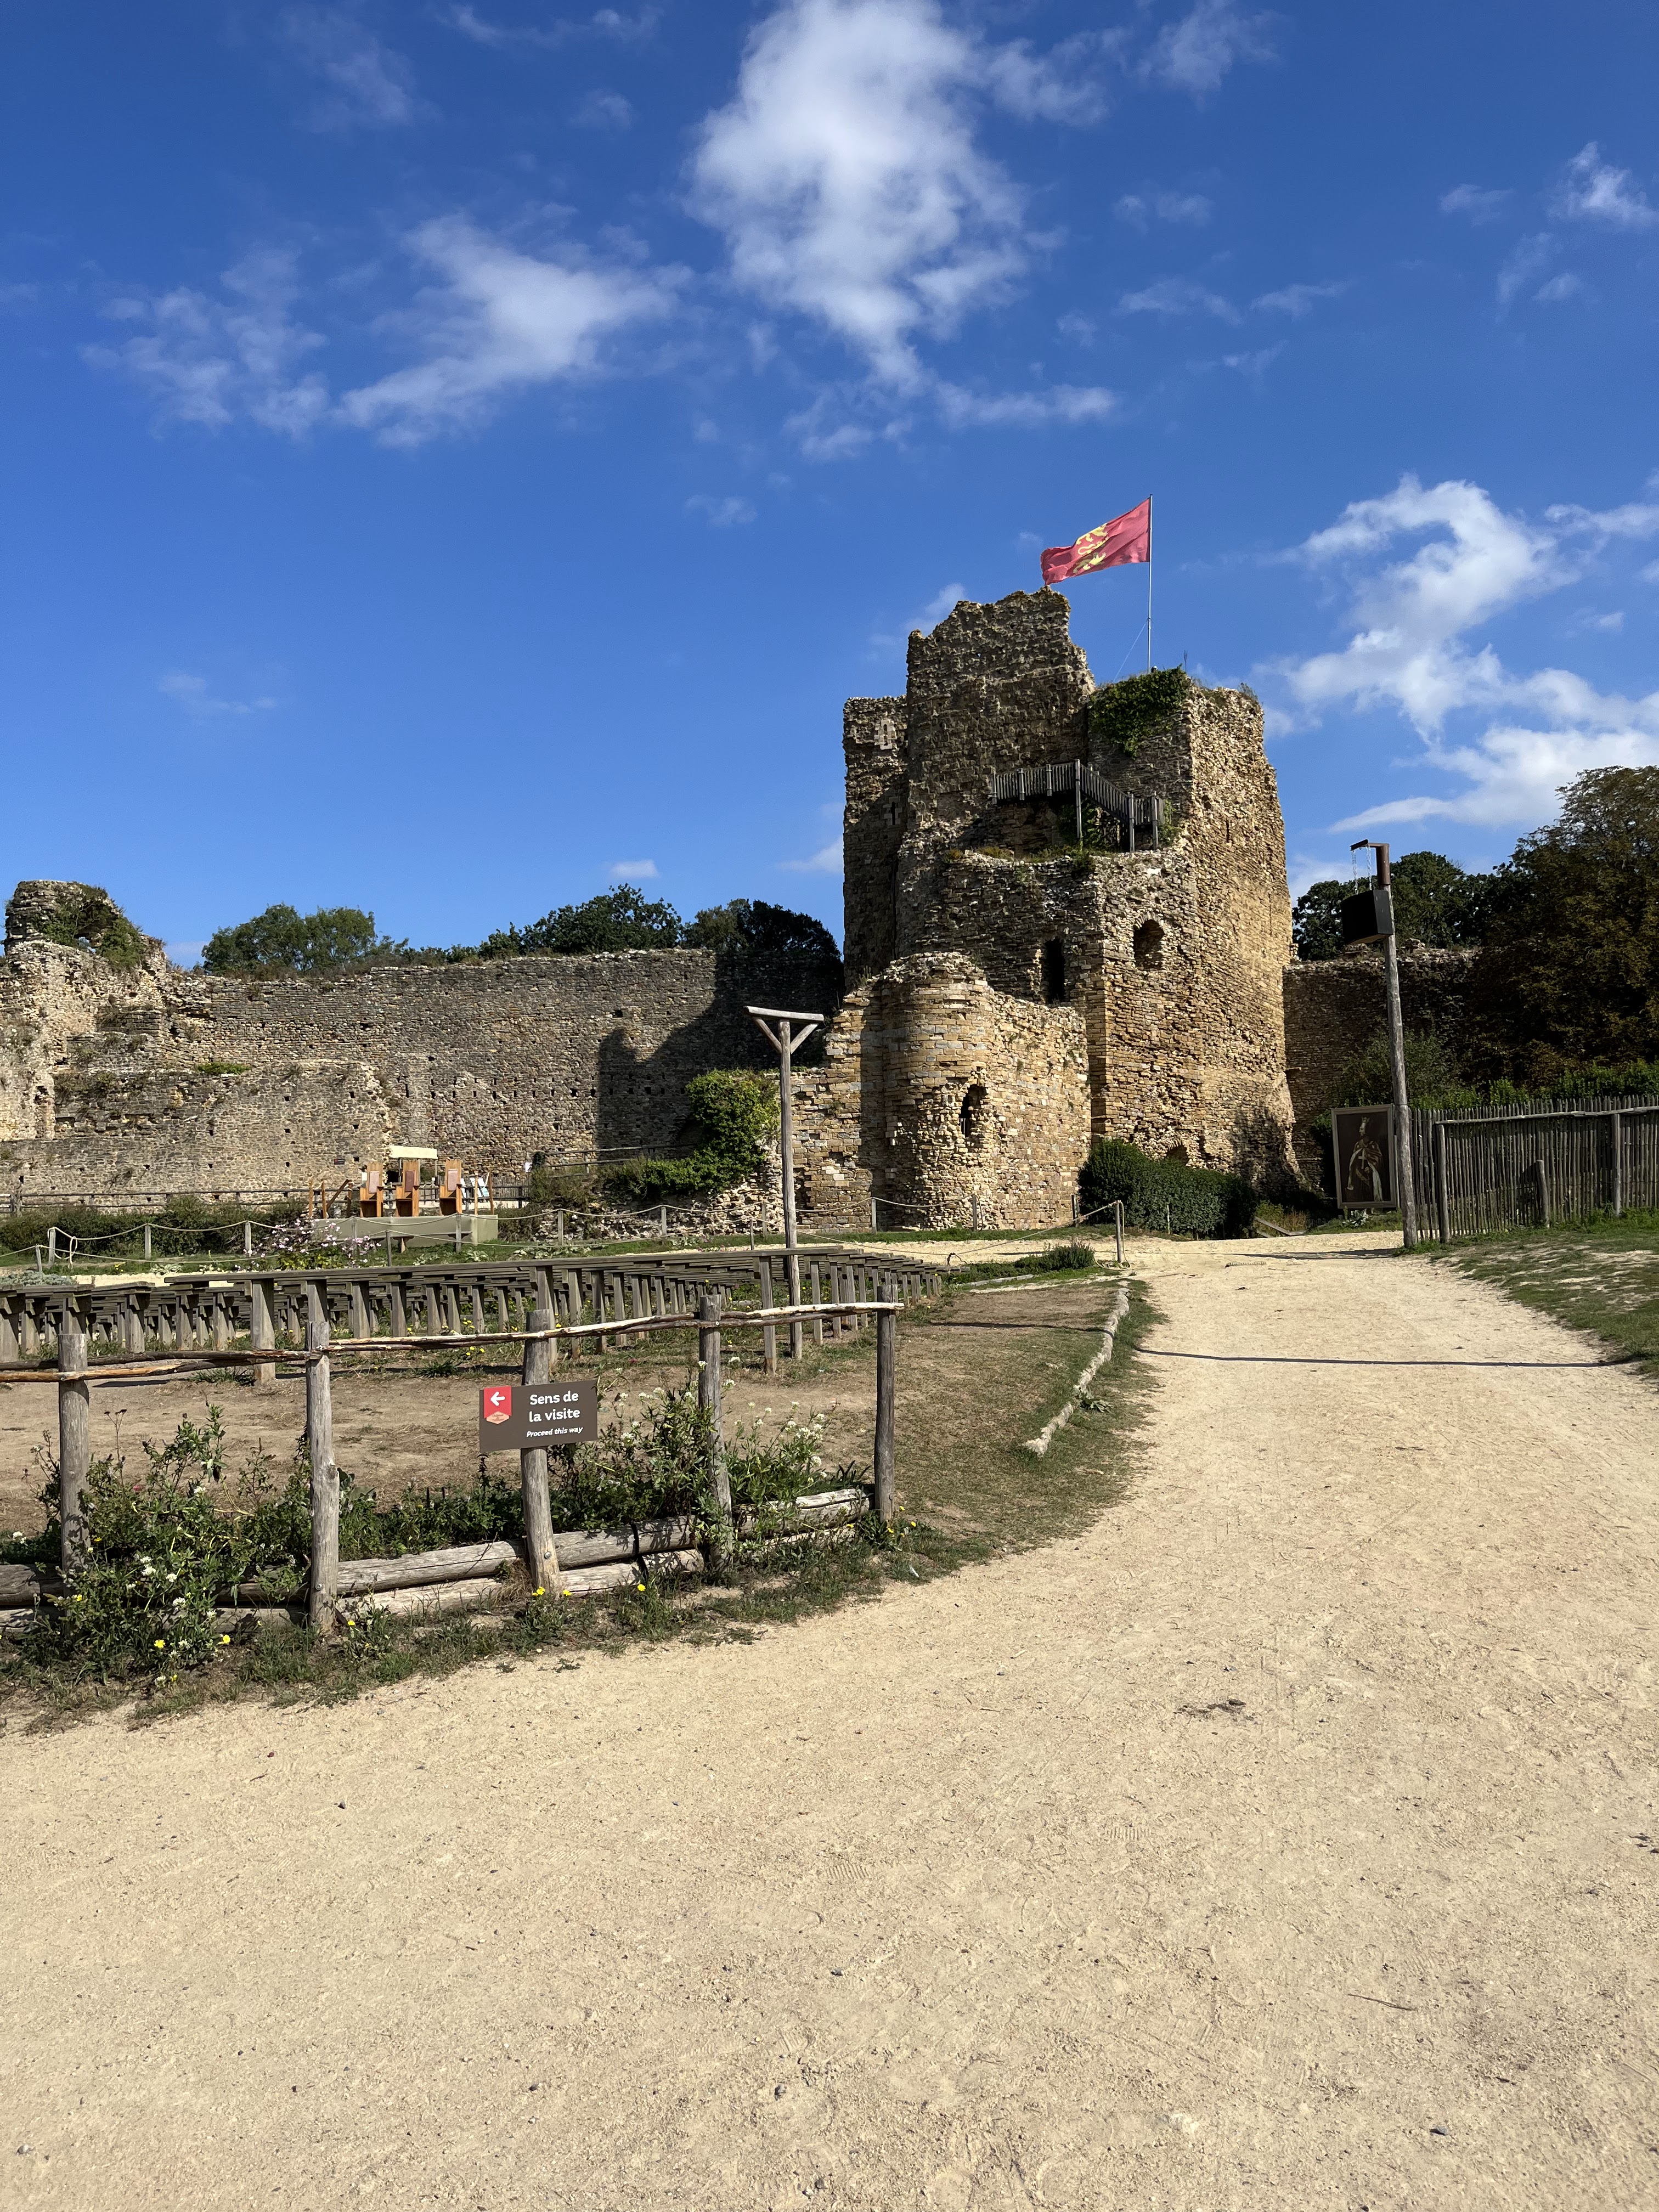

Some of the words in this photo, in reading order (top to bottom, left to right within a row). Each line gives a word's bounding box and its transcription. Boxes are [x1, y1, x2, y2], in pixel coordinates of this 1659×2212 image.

[529, 1394, 560, 1406] Sens
[563, 1390, 579, 1402] de
[529, 1410, 542, 1423] la
[544, 1407, 580, 1421] visite
[526, 1429, 553, 1437] Proceed
